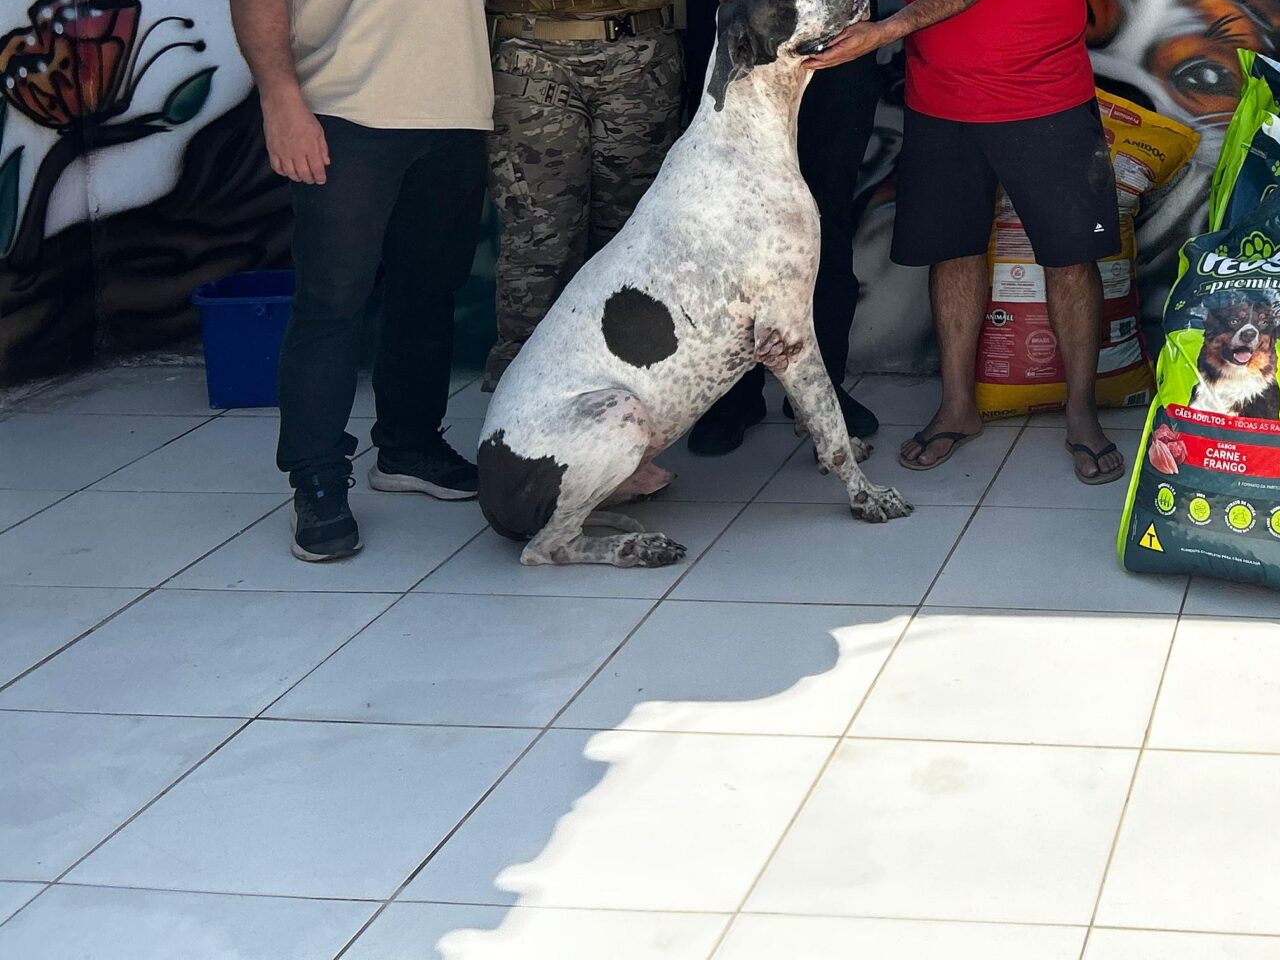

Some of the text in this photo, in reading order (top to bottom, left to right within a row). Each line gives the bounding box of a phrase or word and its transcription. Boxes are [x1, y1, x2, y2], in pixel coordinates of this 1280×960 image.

[1123, 138, 1167, 162] ANIDOG
[1174, 407, 1192, 420] CÃES
[1192, 412, 1226, 426] ADULTOS
[1234, 421, 1258, 431] TODAS
[1259, 422, 1269, 431] AS
[1217, 442, 1237, 450] SABOR
[1205, 447, 1240, 462] CARNE
[1203, 457, 1247, 473] FRANGO
[1147, 532, 1156, 548] T
